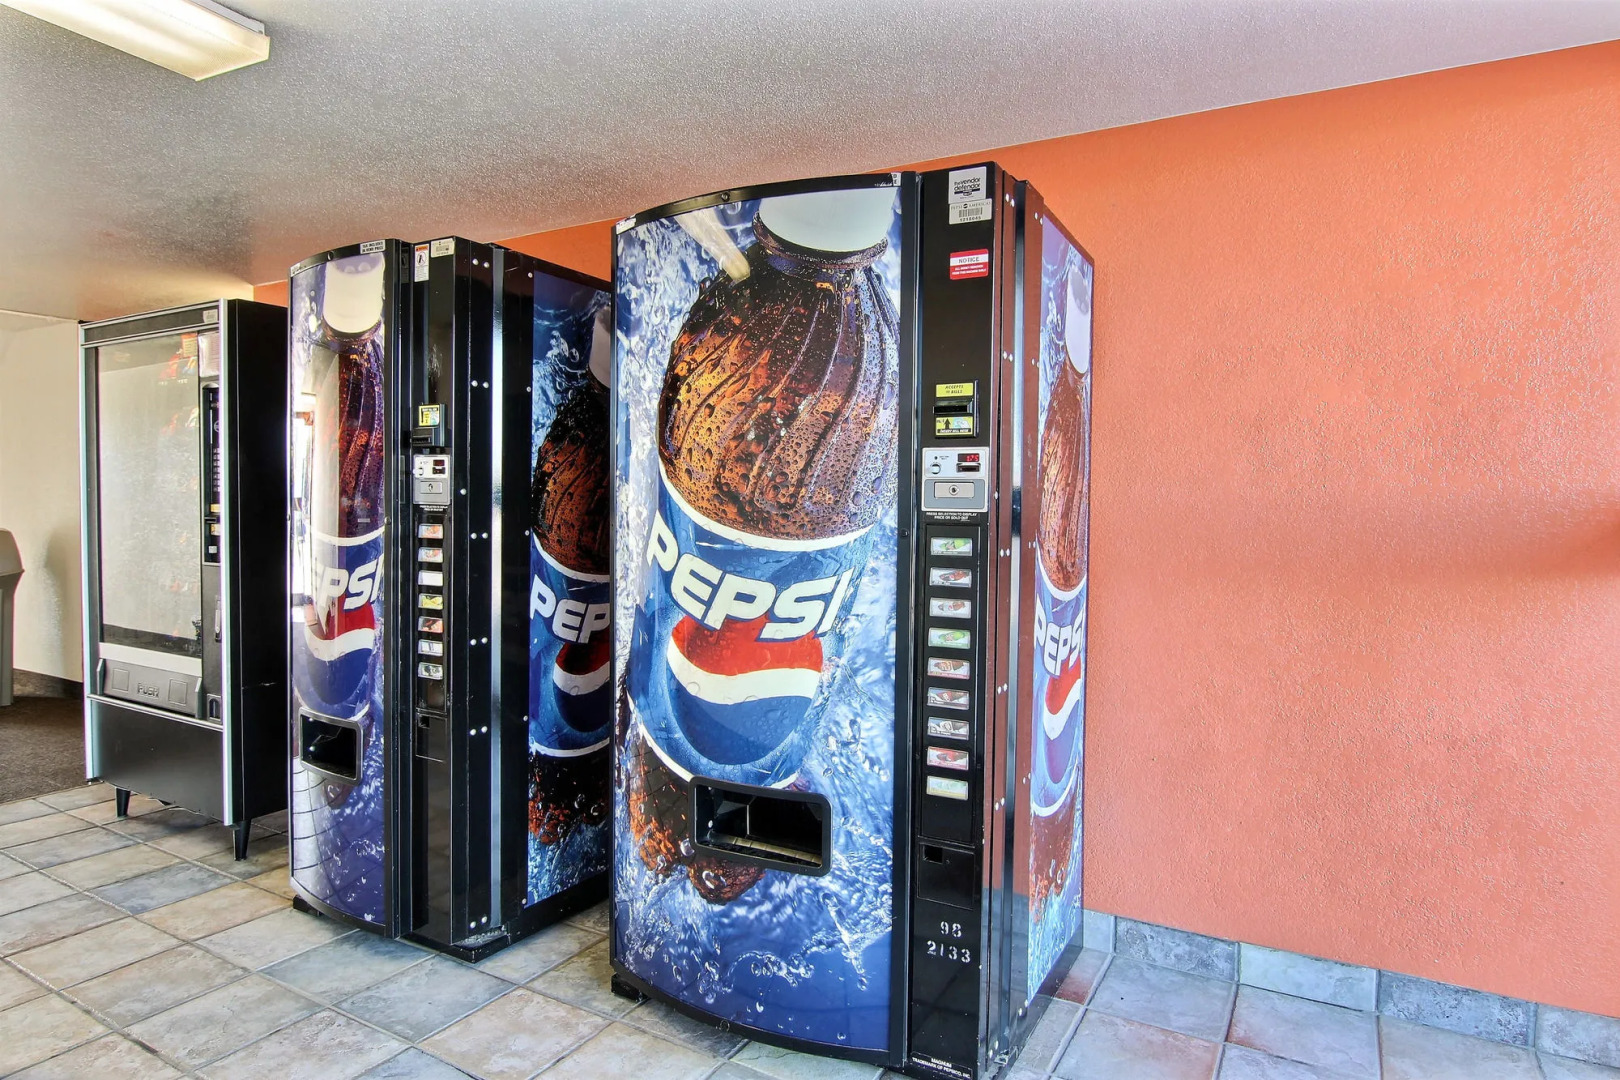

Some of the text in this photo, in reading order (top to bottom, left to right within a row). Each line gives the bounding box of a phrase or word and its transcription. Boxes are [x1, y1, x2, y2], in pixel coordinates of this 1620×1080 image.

[646, 510, 854, 640] PEPSI
[530, 574, 610, 644] PEP
[137, 682, 160, 698] PUSH
[940, 922, 962, 938] 98
[926, 940, 972, 963] 2133
[912, 1057, 937, 1068] TRADEMARK
[931, 1058, 952, 1068] MAGNUM
